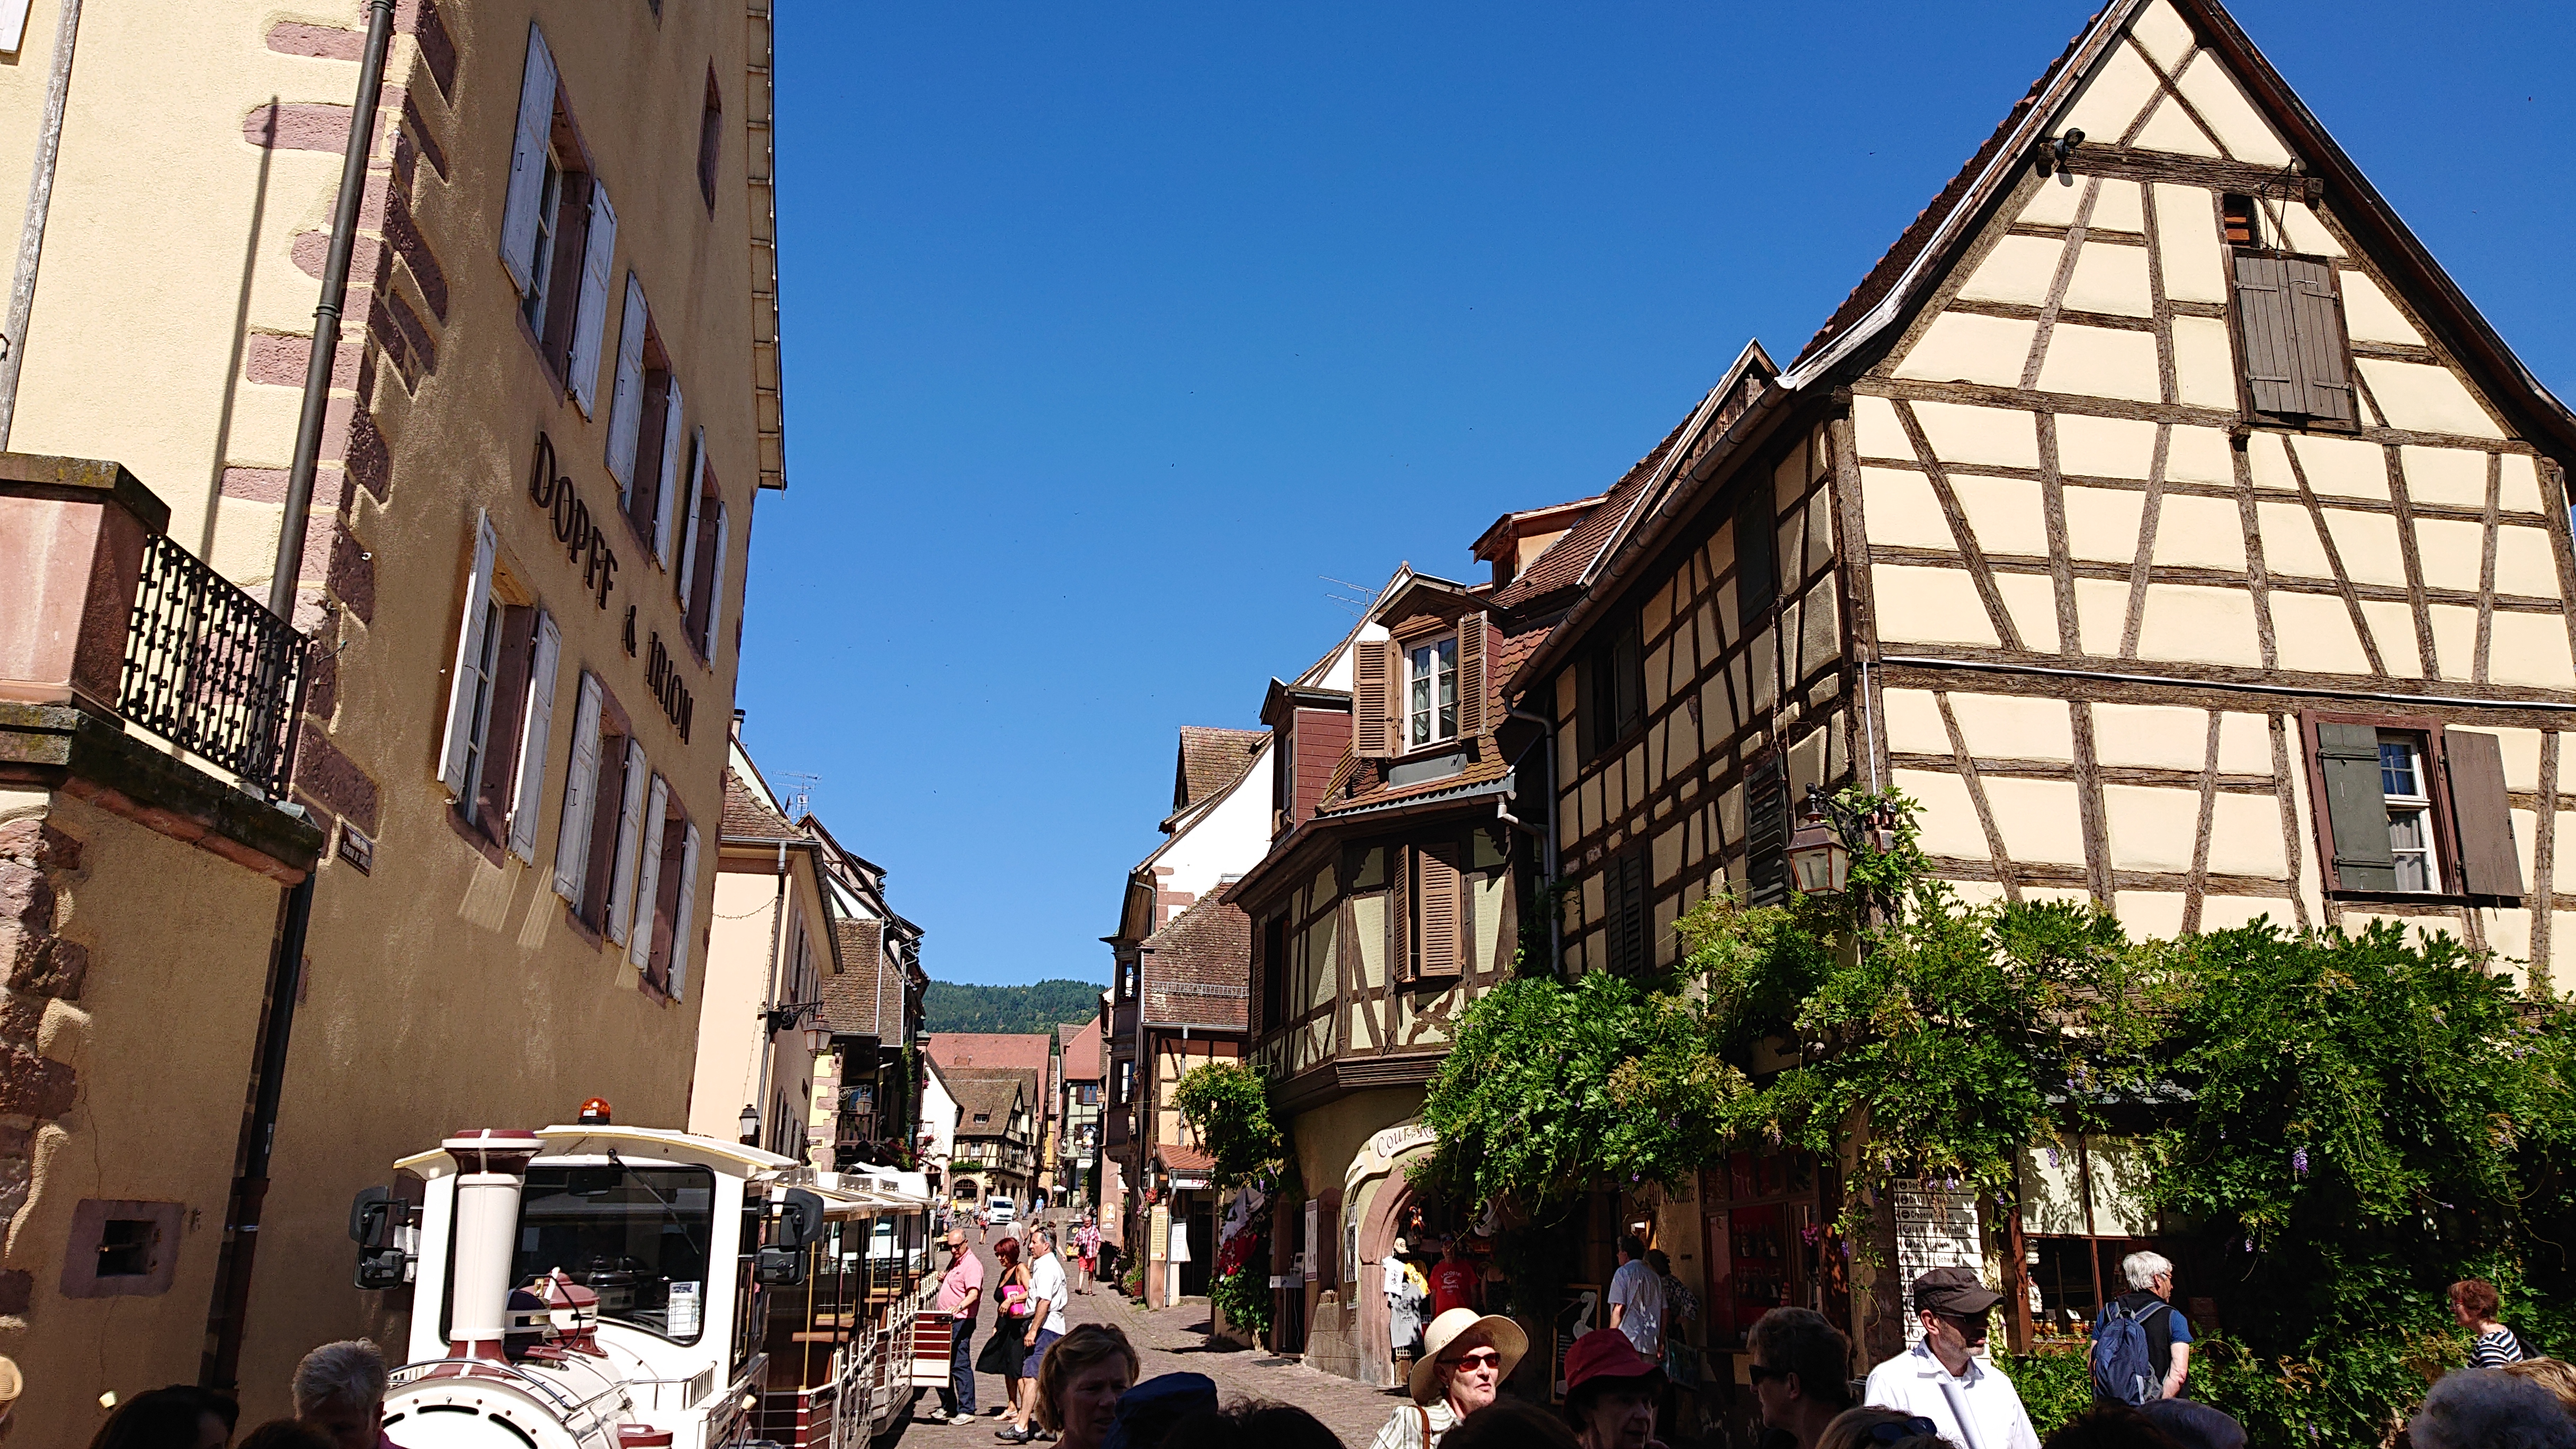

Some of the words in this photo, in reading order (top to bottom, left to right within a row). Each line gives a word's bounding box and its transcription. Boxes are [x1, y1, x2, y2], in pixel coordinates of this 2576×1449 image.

[531, 431, 618, 610] DOPFF
[625, 605, 637, 658] &
[647, 631, 693, 745] IRION
